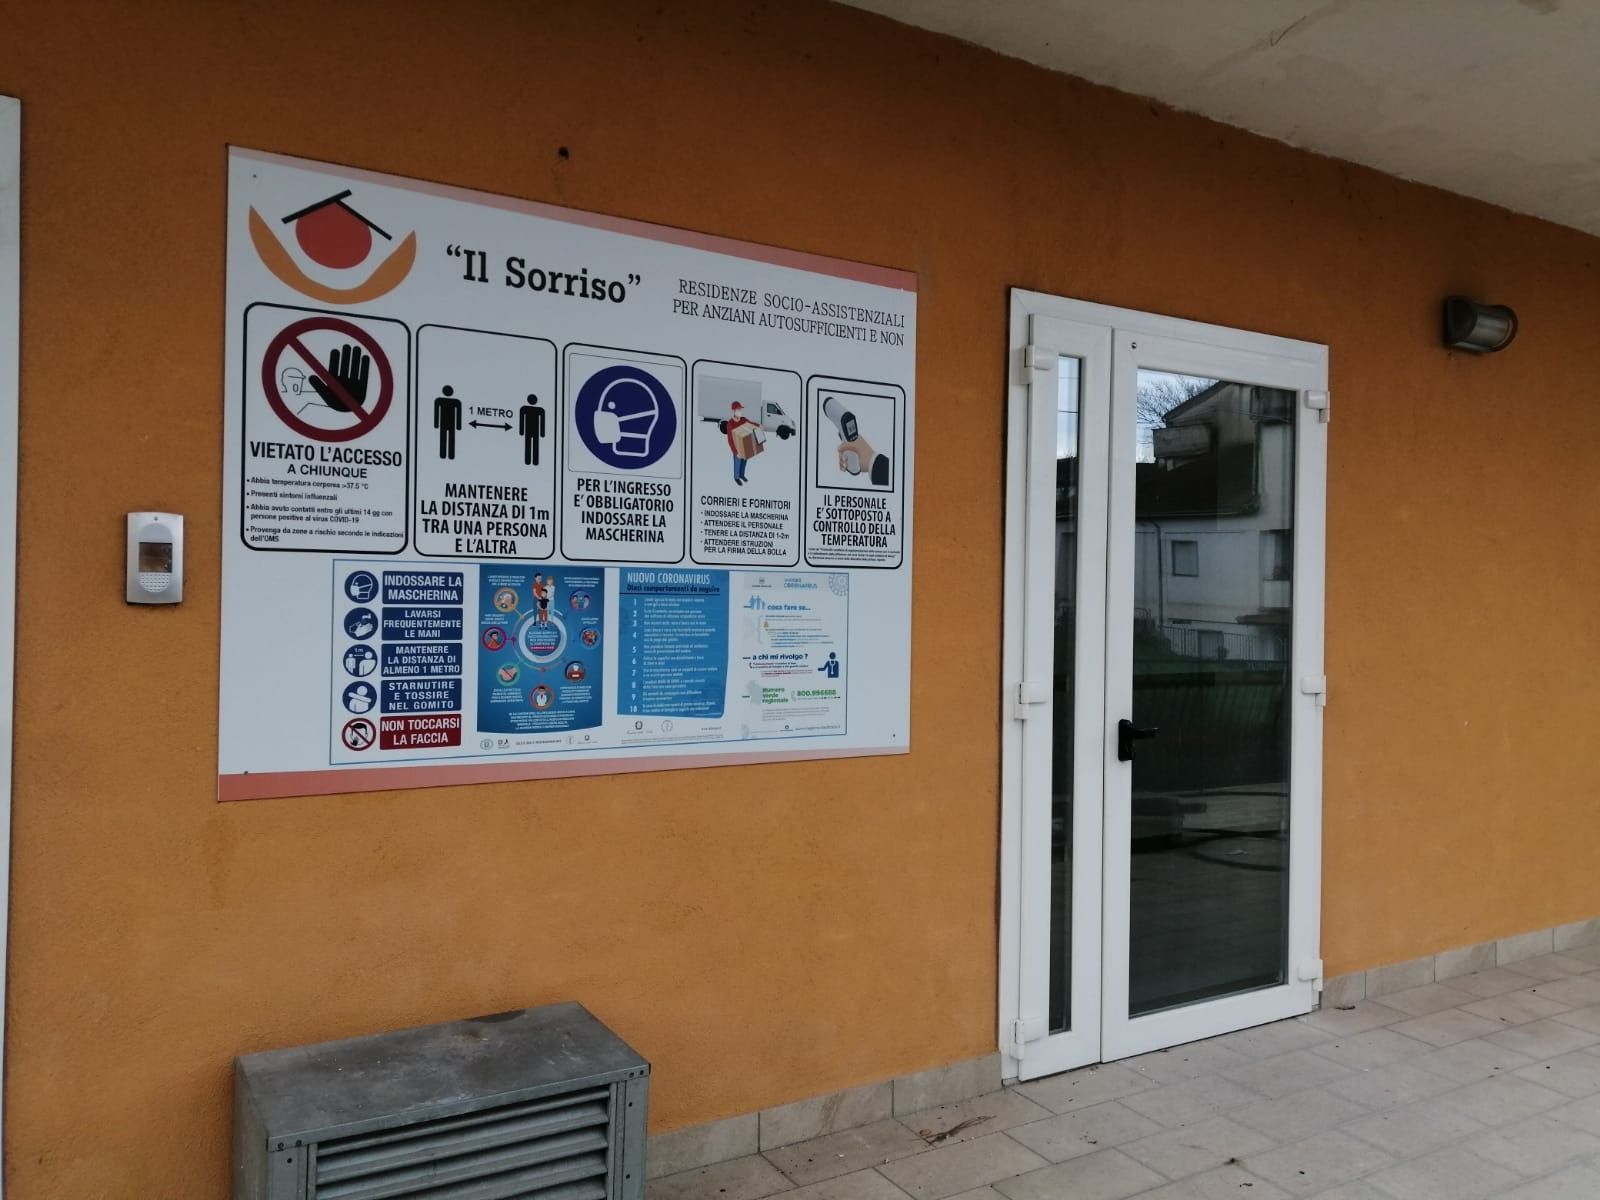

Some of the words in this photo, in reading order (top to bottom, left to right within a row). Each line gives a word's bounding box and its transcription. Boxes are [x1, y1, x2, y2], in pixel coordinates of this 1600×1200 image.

[505, 256, 641, 303] Sorriso”
[678, 278, 758, 305] RESIDENZE
[763, 293, 905, 328] SOCIO-ASSISTENZIALI
[672, 298, 699, 317] PER
[702, 304, 756, 325] ANZIANI
[758, 312, 867, 342] AUTOSUFFICIENTI
[869, 329, 878, 343] E
[880, 331, 905, 347] NON
[468, 406, 474, 415] 1
[477, 407, 514, 419] METRO
[250, 441, 315, 461] VIETATO
[320, 446, 402, 467] L'ACCESSO
[287, 463, 297, 475] A
[300, 464, 368, 479] CHIUNQUE
[445, 482, 528, 502] MANTENERE
[577, 478, 601, 492] PER
[604, 479, 671, 497] L'INGRESSO
[304, 492, 338, 501] influenzali
[701, 495, 740, 507] CORRIERI
[741, 498, 748, 508] E
[749, 499, 791, 510] FORNITORI
[824, 494, 832, 506] IL
[834, 495, 887, 510] PERSONALE
[250, 503, 270, 511] Abbia
[334, 507, 343, 515] gli
[363, 508, 371, 516] 14
[574, 494, 584, 507] E'
[586, 495, 674, 513] OBBLIGATORIO
[421, 500, 438, 516] LA
[442, 501, 508, 519] DISTANZA
[511, 505, 525, 520] DI
[529, 506, 549, 521] 1m
[704, 510, 740, 519] INDOSSARE
[741, 511, 749, 519] LA
[750, 512, 789, 521] MASCHERINA
[825, 507, 883, 522] SOTTOPOSTO
[885, 511, 891, 523] A
[329, 515, 360, 523] COVID-19
[581, 511, 649, 527] INDOSSARE
[652, 514, 667, 528] LA
[704, 519, 740, 528] ATTENDERE
[747, 521, 784, 530] PERSONALE
[250, 525, 281, 535] Provenga
[314, 528, 336, 536] rischio
[422, 518, 450, 534] TRA
[453, 520, 483, 536] UNA
[486, 522, 547, 538] PERSONA
[704, 529, 729, 537] TENERE
[730, 529, 738, 537] LA
[739, 530, 768, 538] DISTANZA
[768, 531, 775, 539] DI
[776, 531, 790, 540] 1-2m
[813, 520, 866, 534] CONTROLLO
[868, 522, 896, 536] DELLA
[585, 527, 665, 543] MASCHERINA
[821, 533, 888, 548] TEMPERATURA
[455, 538, 462, 553] E
[466, 538, 517, 555] L'ALTRA
[704, 538, 740, 547] ATTENDERE
[740, 540, 774, 548] ISTRUZIONI
[718, 546, 726, 554] LA
[746, 547, 766, 555] DELLA
[767, 548, 787, 556] BOLLA
[384, 575, 445, 587] INDOSSARE
[448, 576, 462, 587] LA
[627, 572, 655, 584] NUOVO
[657, 573, 711, 585] CORONAVIRUS
[388, 589, 459, 601] MASCHERINA
[643, 585, 689, 593] comportamenti
[404, 609, 441, 618] LAVARSI
[383, 620, 462, 628] FREQUENTEMENTE
[404, 629, 415, 638] LE
[418, 629, 441, 638] MANI
[395, 645, 449, 654] MANTENERE
[387, 656, 399, 665] LA
[402, 655, 445, 664] DISTANZA
[447, 655, 456, 663] DI
[780, 653, 803, 661] rivolgo
[383, 665, 420, 675] ALMENO
[422, 666, 427, 674] 1
[430, 664, 460, 673] METRO
[388, 681, 455, 691] STARNUTIRE
[394, 692, 400, 700] E
[405, 691, 449, 700] TOSSIRE
[389, 702, 409, 711] NEL
[413, 700, 454, 710] GOMITO
[381, 720, 405, 732] NON
[407, 718, 460, 731] TOCCARSI
[393, 734, 407, 745] LA
[410, 732, 448, 744] FACCIA
